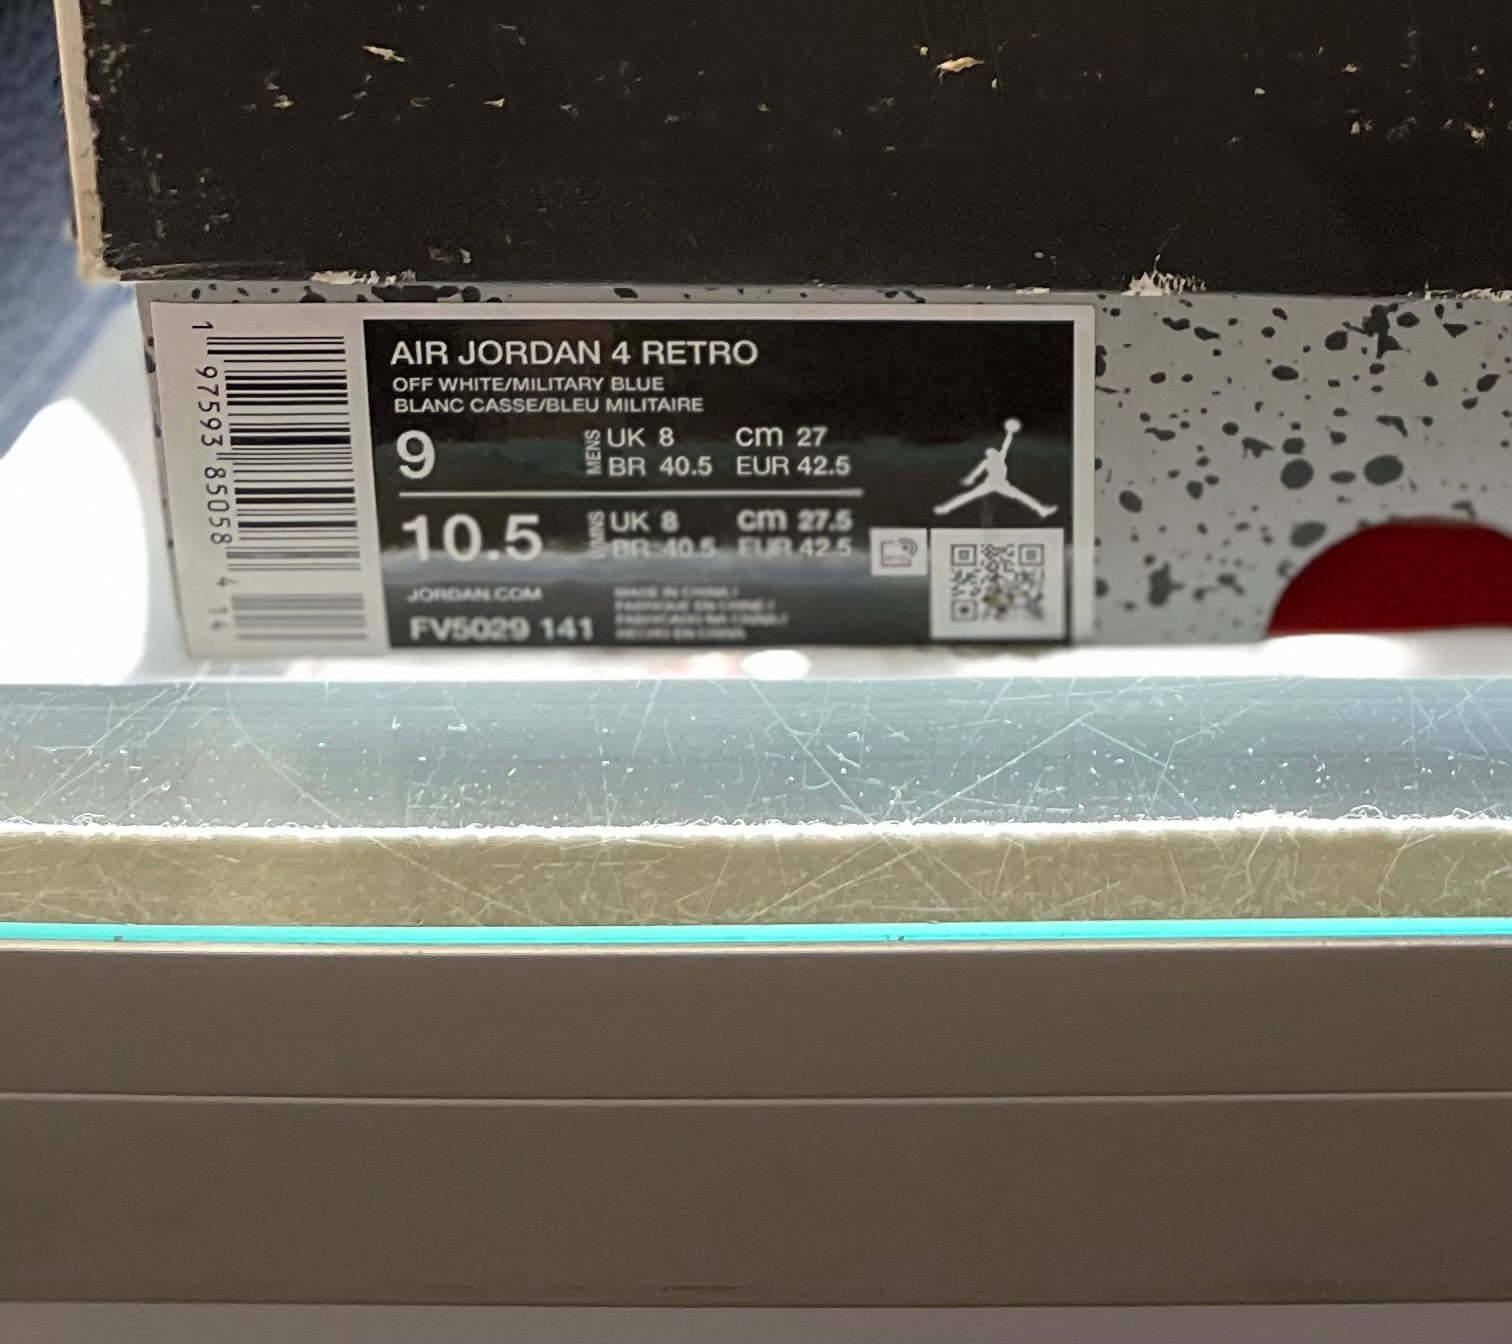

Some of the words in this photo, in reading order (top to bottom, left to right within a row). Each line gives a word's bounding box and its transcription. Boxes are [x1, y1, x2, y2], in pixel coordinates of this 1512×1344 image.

[390, 340, 448, 365] AIR
[458, 340, 601, 365] JORDAN
[611, 340, 631, 365] 4
[643, 340, 758, 365] RETRO
[392, 376, 433, 392] OFF
[438, 376, 604, 392] WHITE/MILITARY
[611, 376, 665, 392] BLUE
[394, 398, 464, 413] BLANC
[605, 397, 704, 412] MILITAIRE
[607, 428, 645, 448] UK
[658, 427, 675, 447] 8
[735, 427, 783, 447] cm
[797, 427, 828, 447] 27
[395, 429, 436, 480] 9
[585, 429, 602, 475] MENS
[608, 457, 646, 476] BR
[659, 456, 712, 476] 40.5
[736, 456, 789, 476] EUR
[797, 456, 850, 476] 42.5
[610, 511, 650, 531] UK
[660, 510, 679, 532] 8
[736, 509, 788, 531] cm
[797, 509, 853, 531] 27.5
[401, 513, 543, 562] 10.5
[407, 586, 543, 602] JORDAN.COM
[409, 615, 531, 641] FV5029
[540, 615, 594, 641] 141
